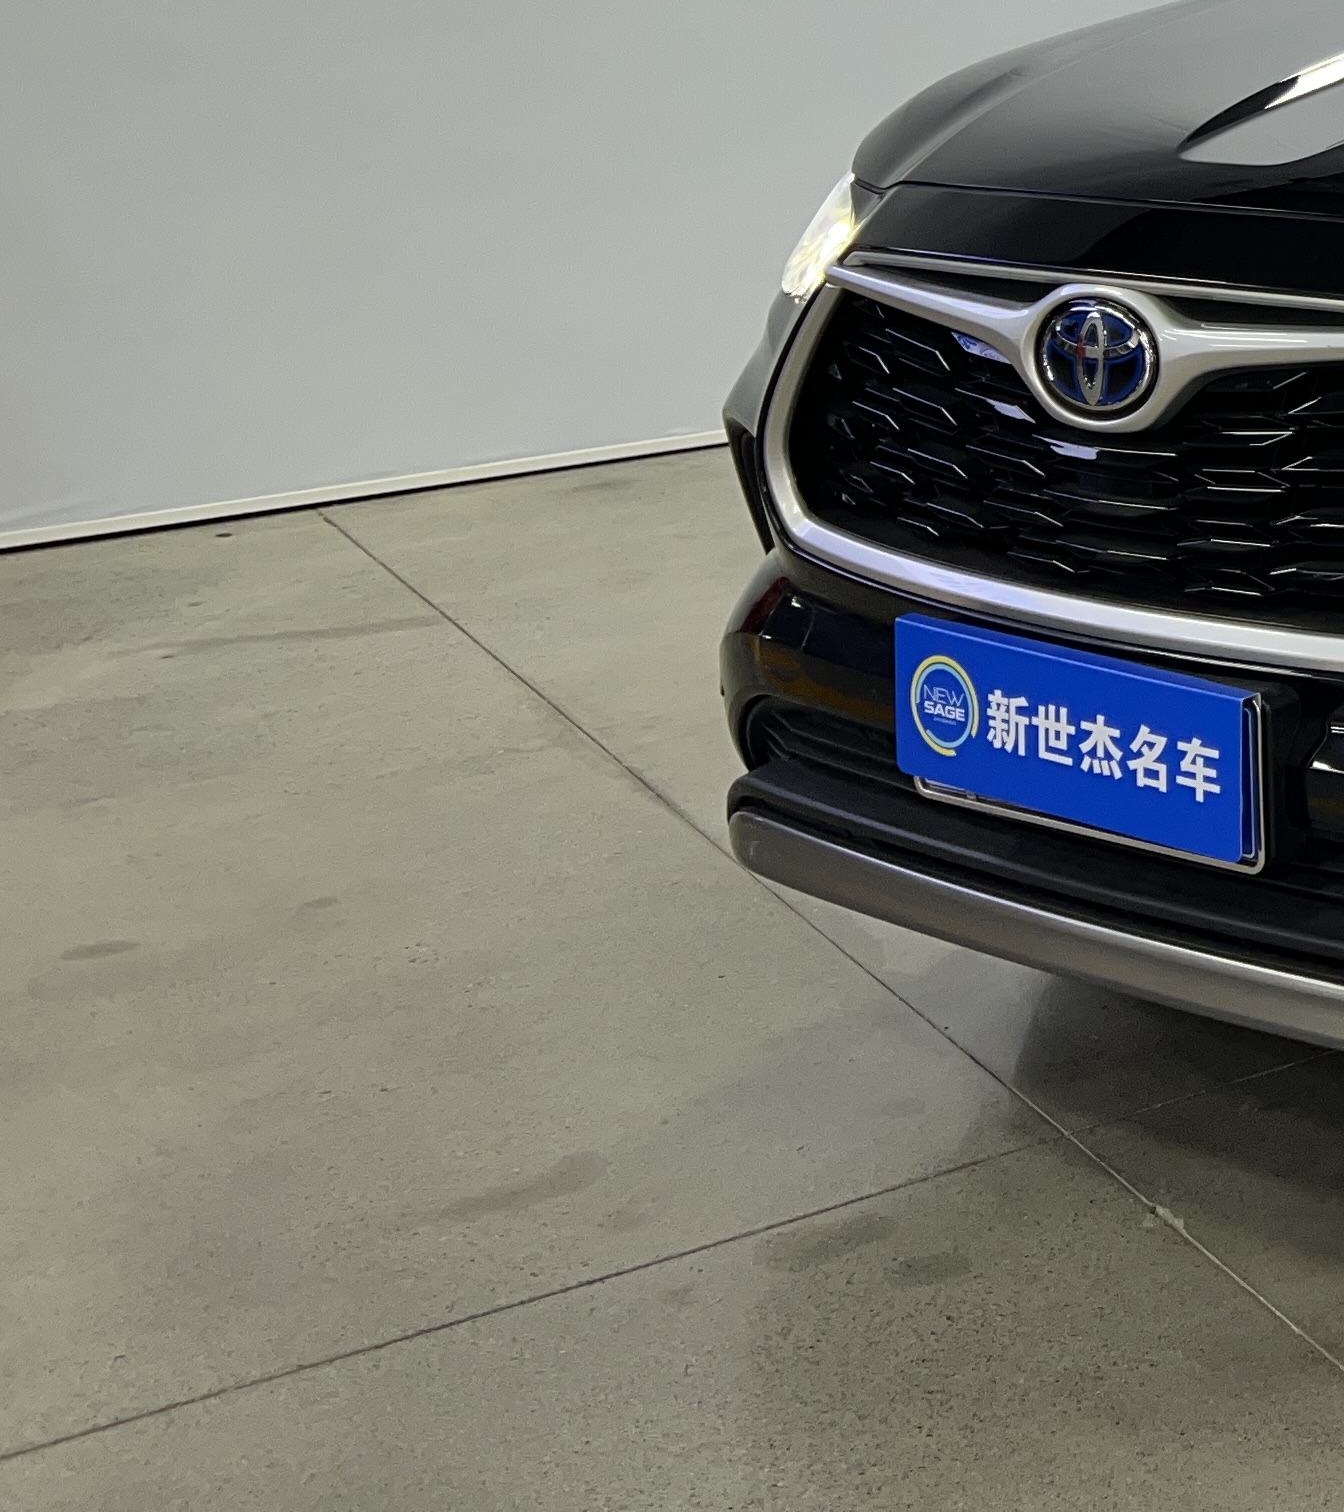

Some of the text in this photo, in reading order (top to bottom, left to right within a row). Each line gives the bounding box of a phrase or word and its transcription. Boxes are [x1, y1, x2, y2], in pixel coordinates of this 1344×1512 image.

[923, 684, 965, 707] NEW
[923, 700, 966, 722] SAGE
[986, 689, 1221, 803] 新世杰名车
